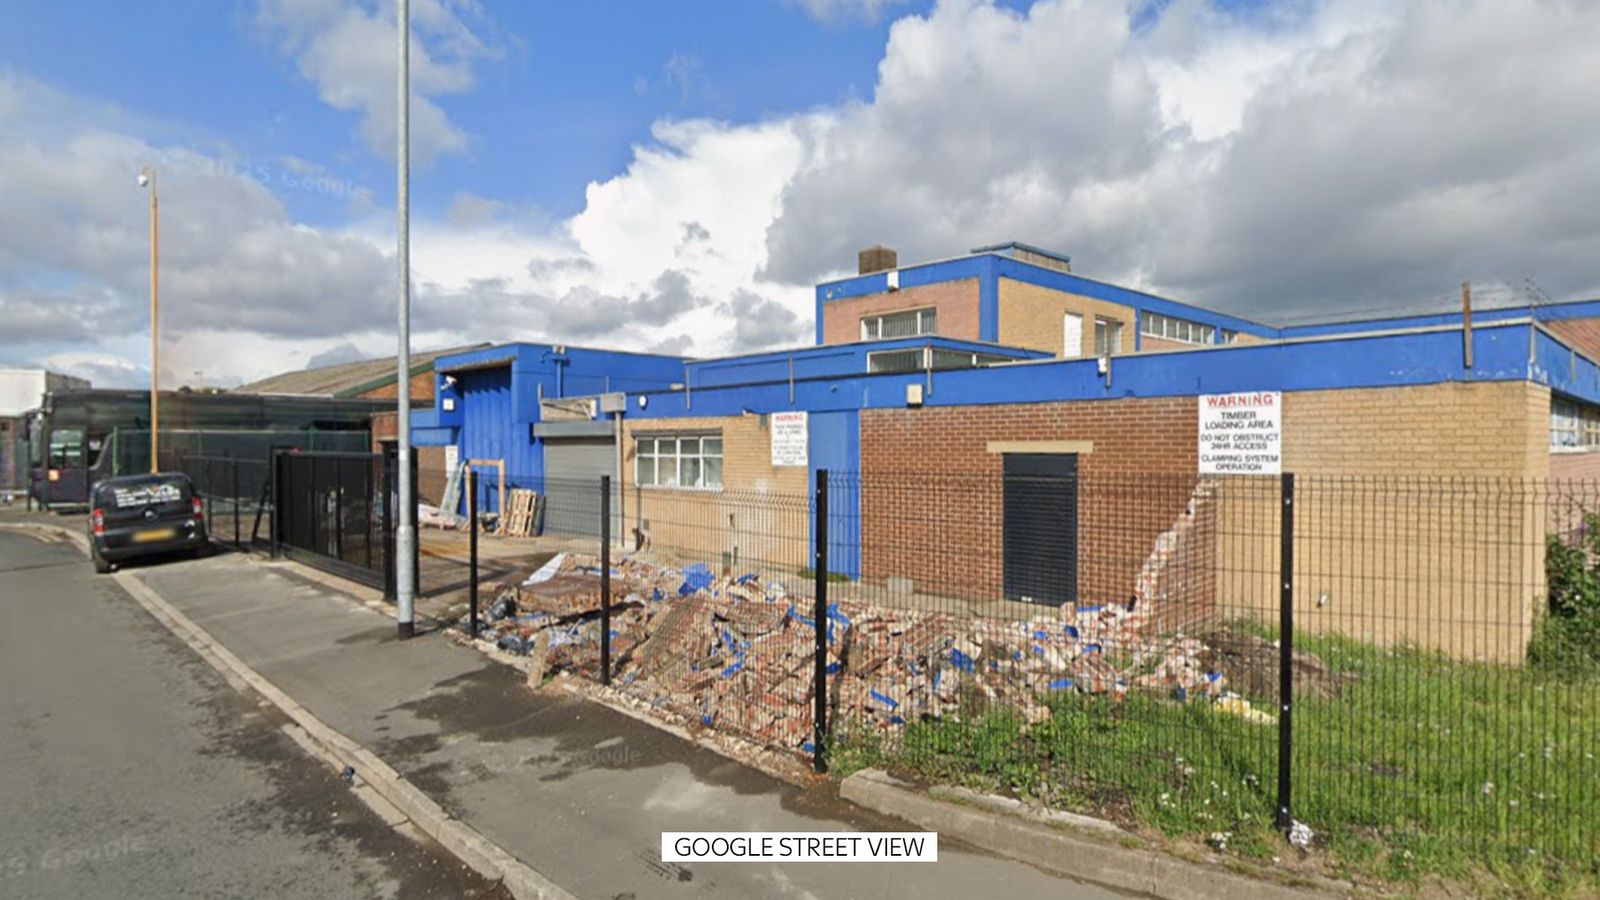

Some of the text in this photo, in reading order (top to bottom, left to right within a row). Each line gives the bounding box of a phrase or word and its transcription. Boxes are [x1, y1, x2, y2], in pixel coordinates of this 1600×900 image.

[1207, 394, 1274, 407] WARNING
[1221, 411, 1257, 420] TIMBER
[1205, 420, 1273, 430] LOADING AREA
[1200, 434, 1213, 442] DO
[1233, 433, 1279, 442] OBSTRUCT
[1211, 442, 1268, 450] 24HR ACCESS
[1201, 454, 1279, 463] CLAMPING SYSTEM
[1216, 462, 1262, 471] OPERATION
